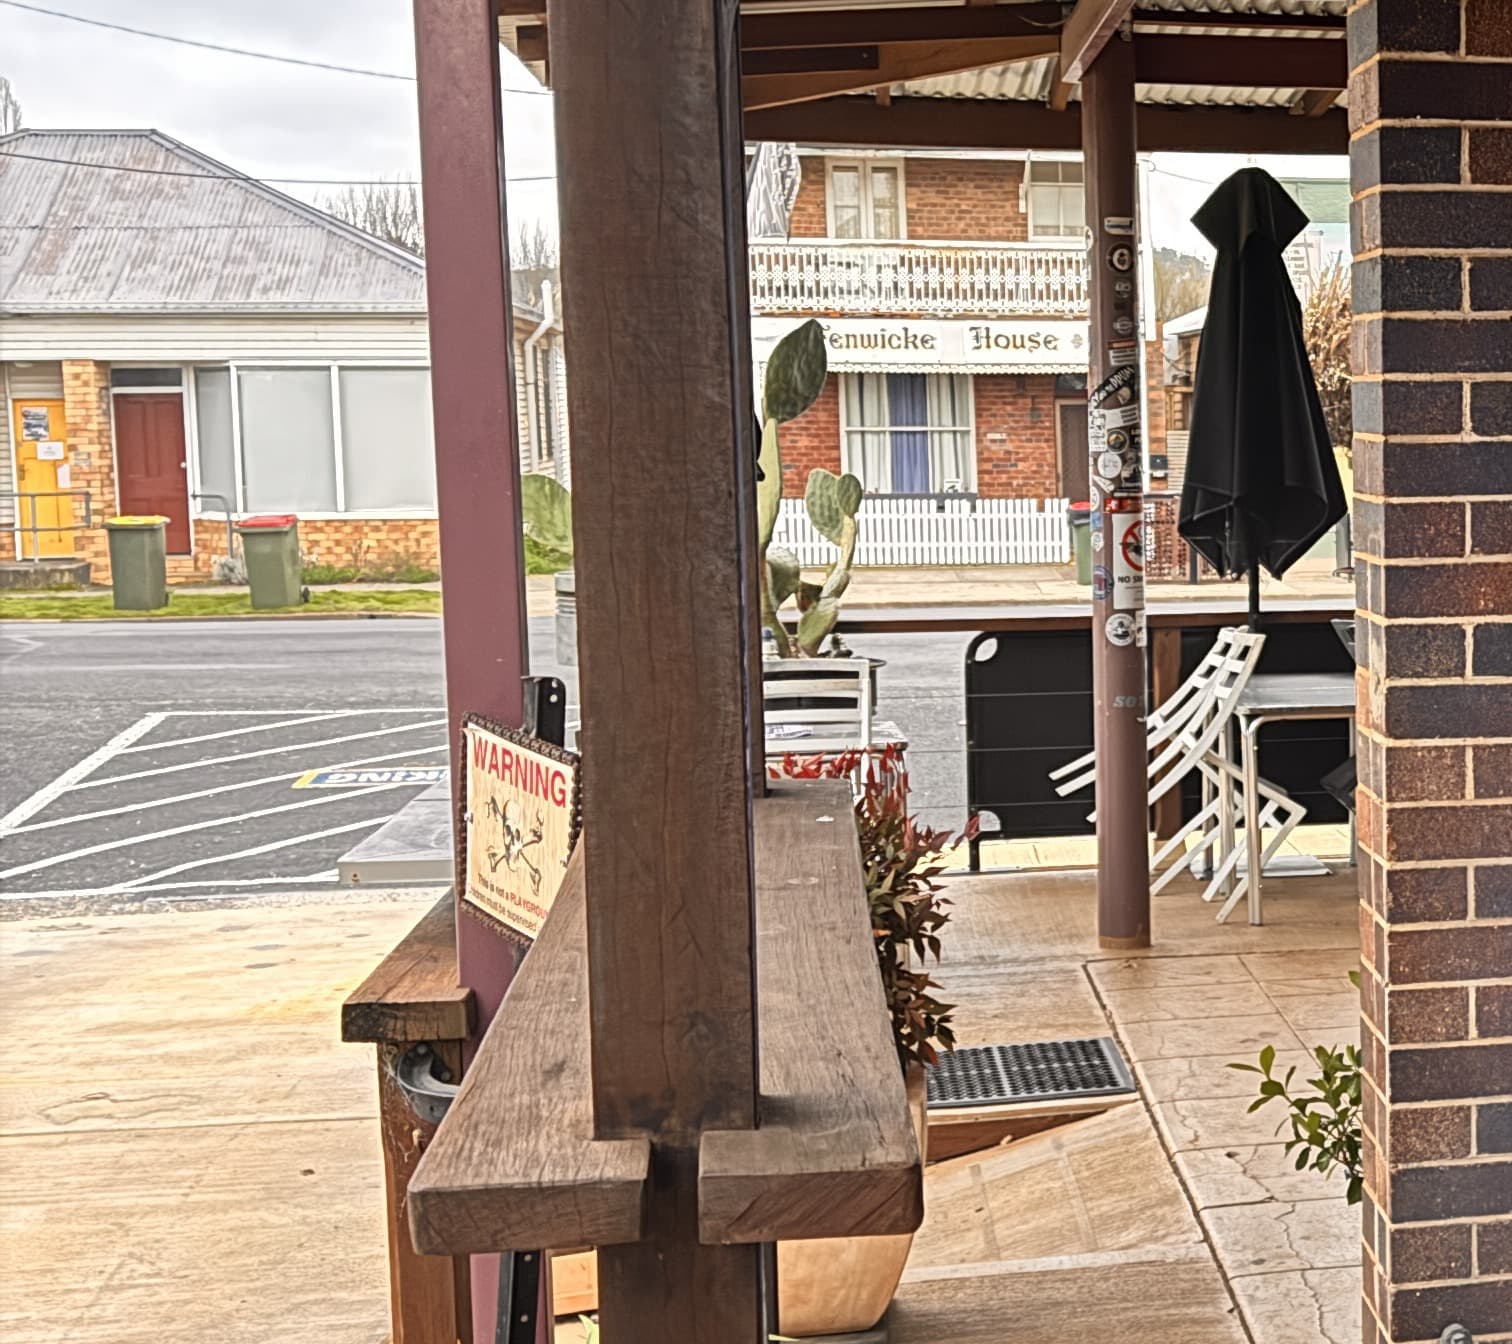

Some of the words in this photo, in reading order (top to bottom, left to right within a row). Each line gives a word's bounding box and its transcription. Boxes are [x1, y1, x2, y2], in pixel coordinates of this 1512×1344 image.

[823, 325, 937, 350] enwicke
[969, 327, 1060, 353] House
[471, 731, 567, 809] WARNING
